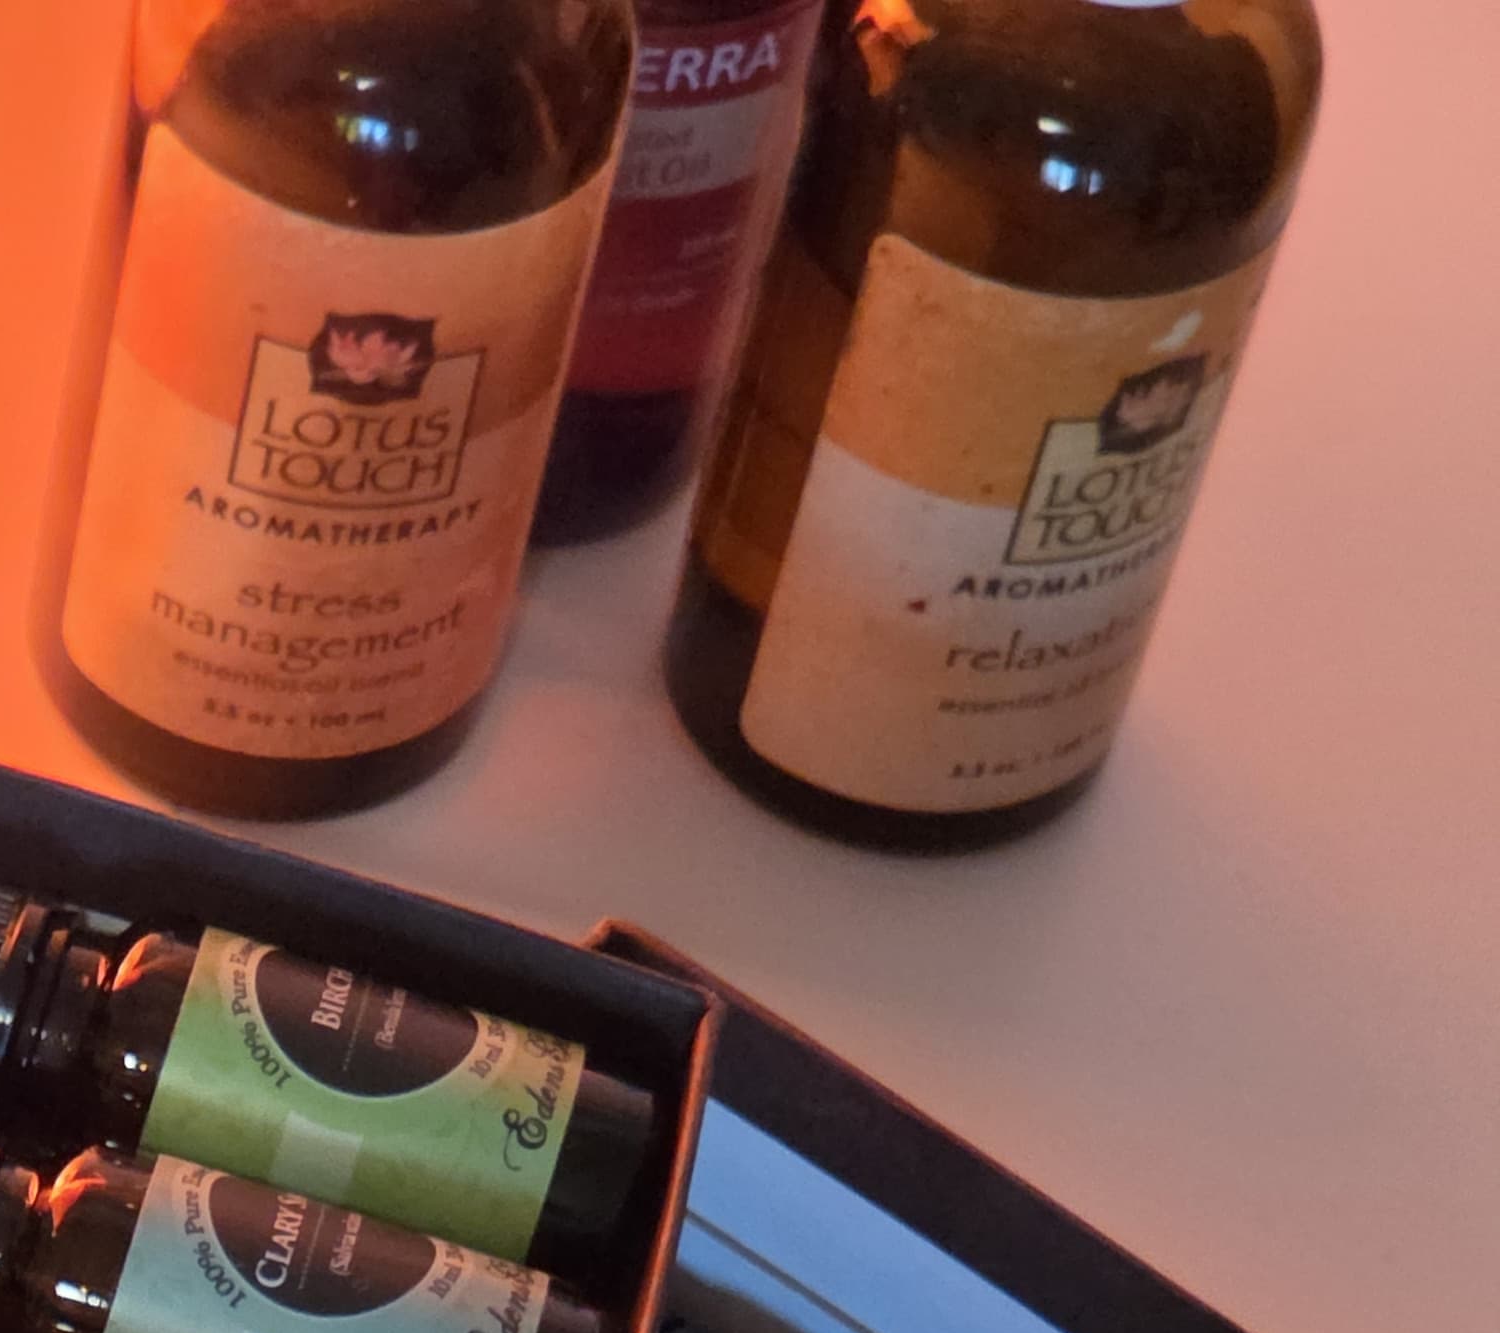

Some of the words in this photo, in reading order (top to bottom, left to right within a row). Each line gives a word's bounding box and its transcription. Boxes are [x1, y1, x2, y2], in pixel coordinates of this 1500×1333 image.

[259, 400, 451, 453] LOTUS
[253, 439, 451, 497] TOUCH
[184, 486, 481, 549] AROMATHERAPY
[152, 588, 465, 674] management
[238, 582, 402, 618] stress
[231, 970, 249, 1020] Pure
[243, 1021, 293, 1091] 100%
[502, 1059, 568, 1171] Edens
[185, 1187, 205, 1238] Pure
[196, 1239, 247, 1310] 100%
[254, 1208, 307, 1289] CLARY
